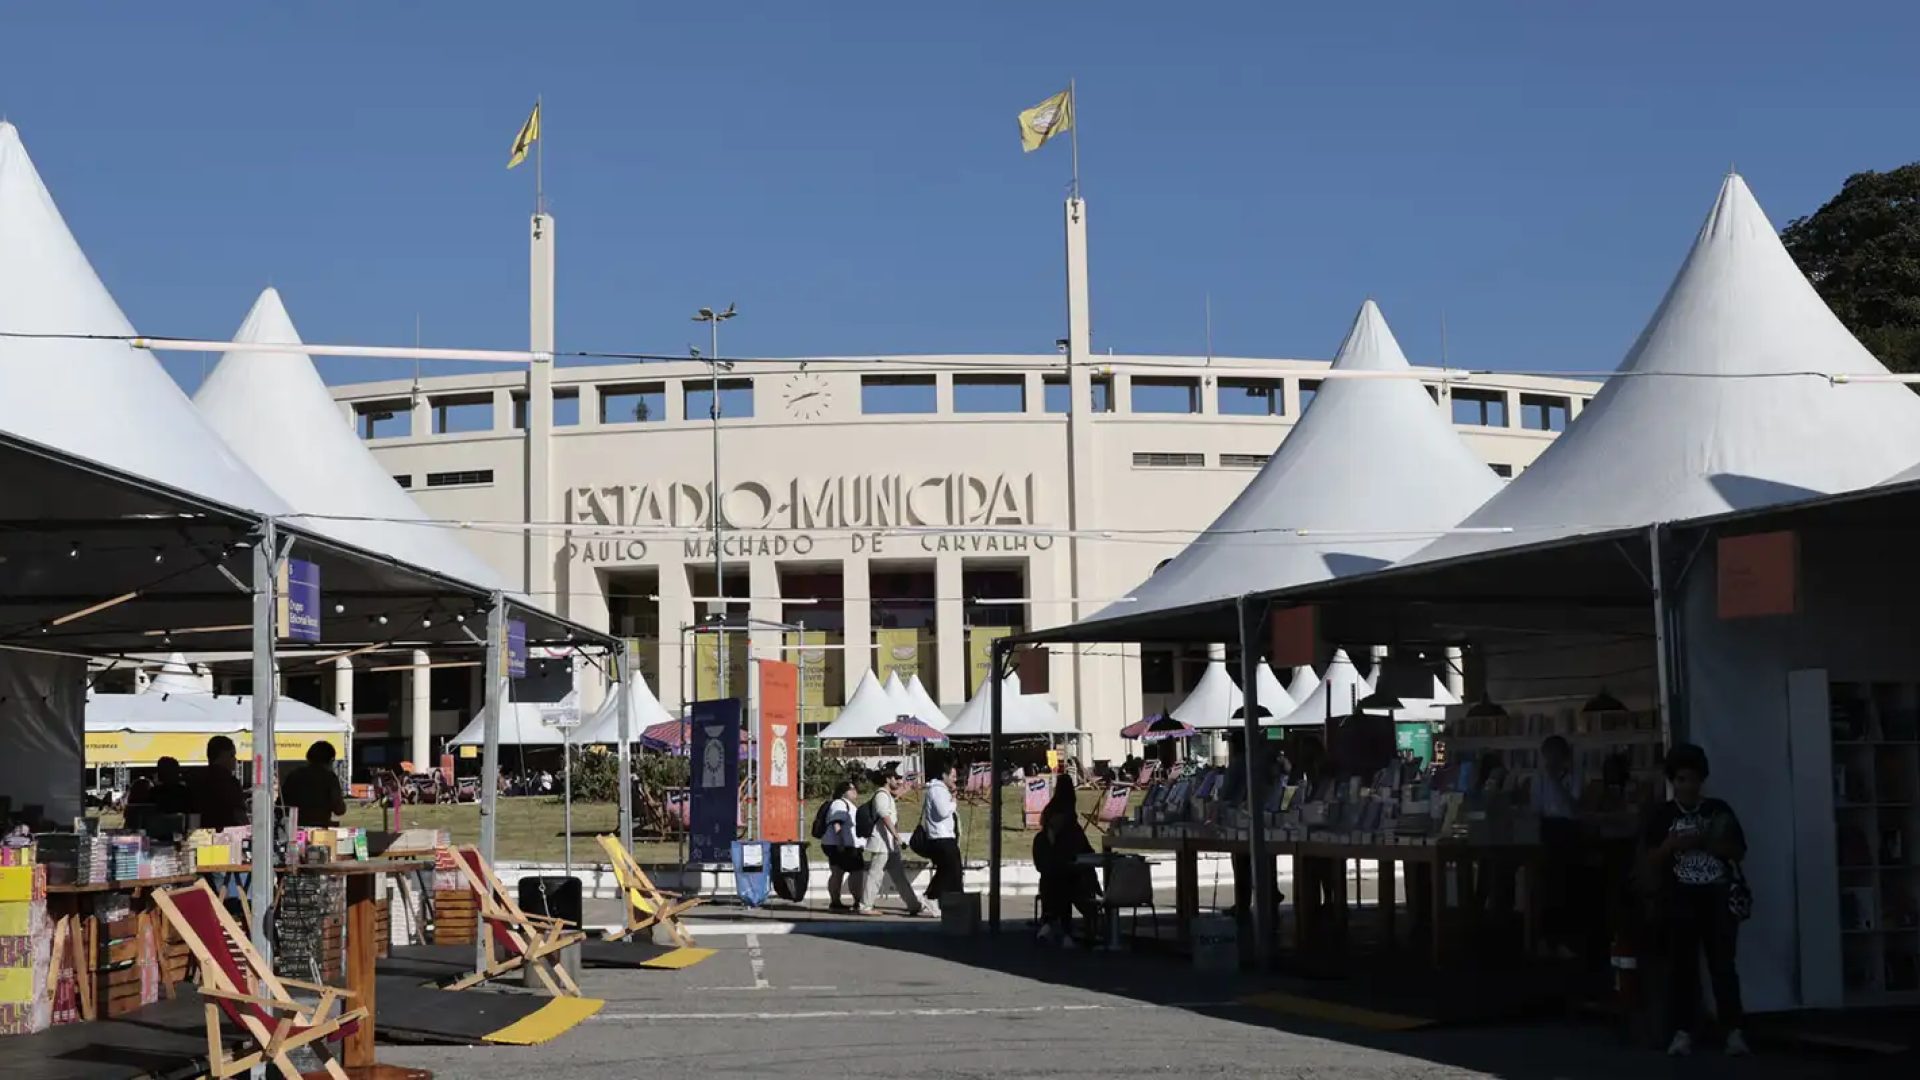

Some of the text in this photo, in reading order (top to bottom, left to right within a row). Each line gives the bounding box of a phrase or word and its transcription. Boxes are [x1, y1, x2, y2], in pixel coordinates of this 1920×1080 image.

[570, 531, 1053, 562] PAULO MACHADO DE CARVALHO
